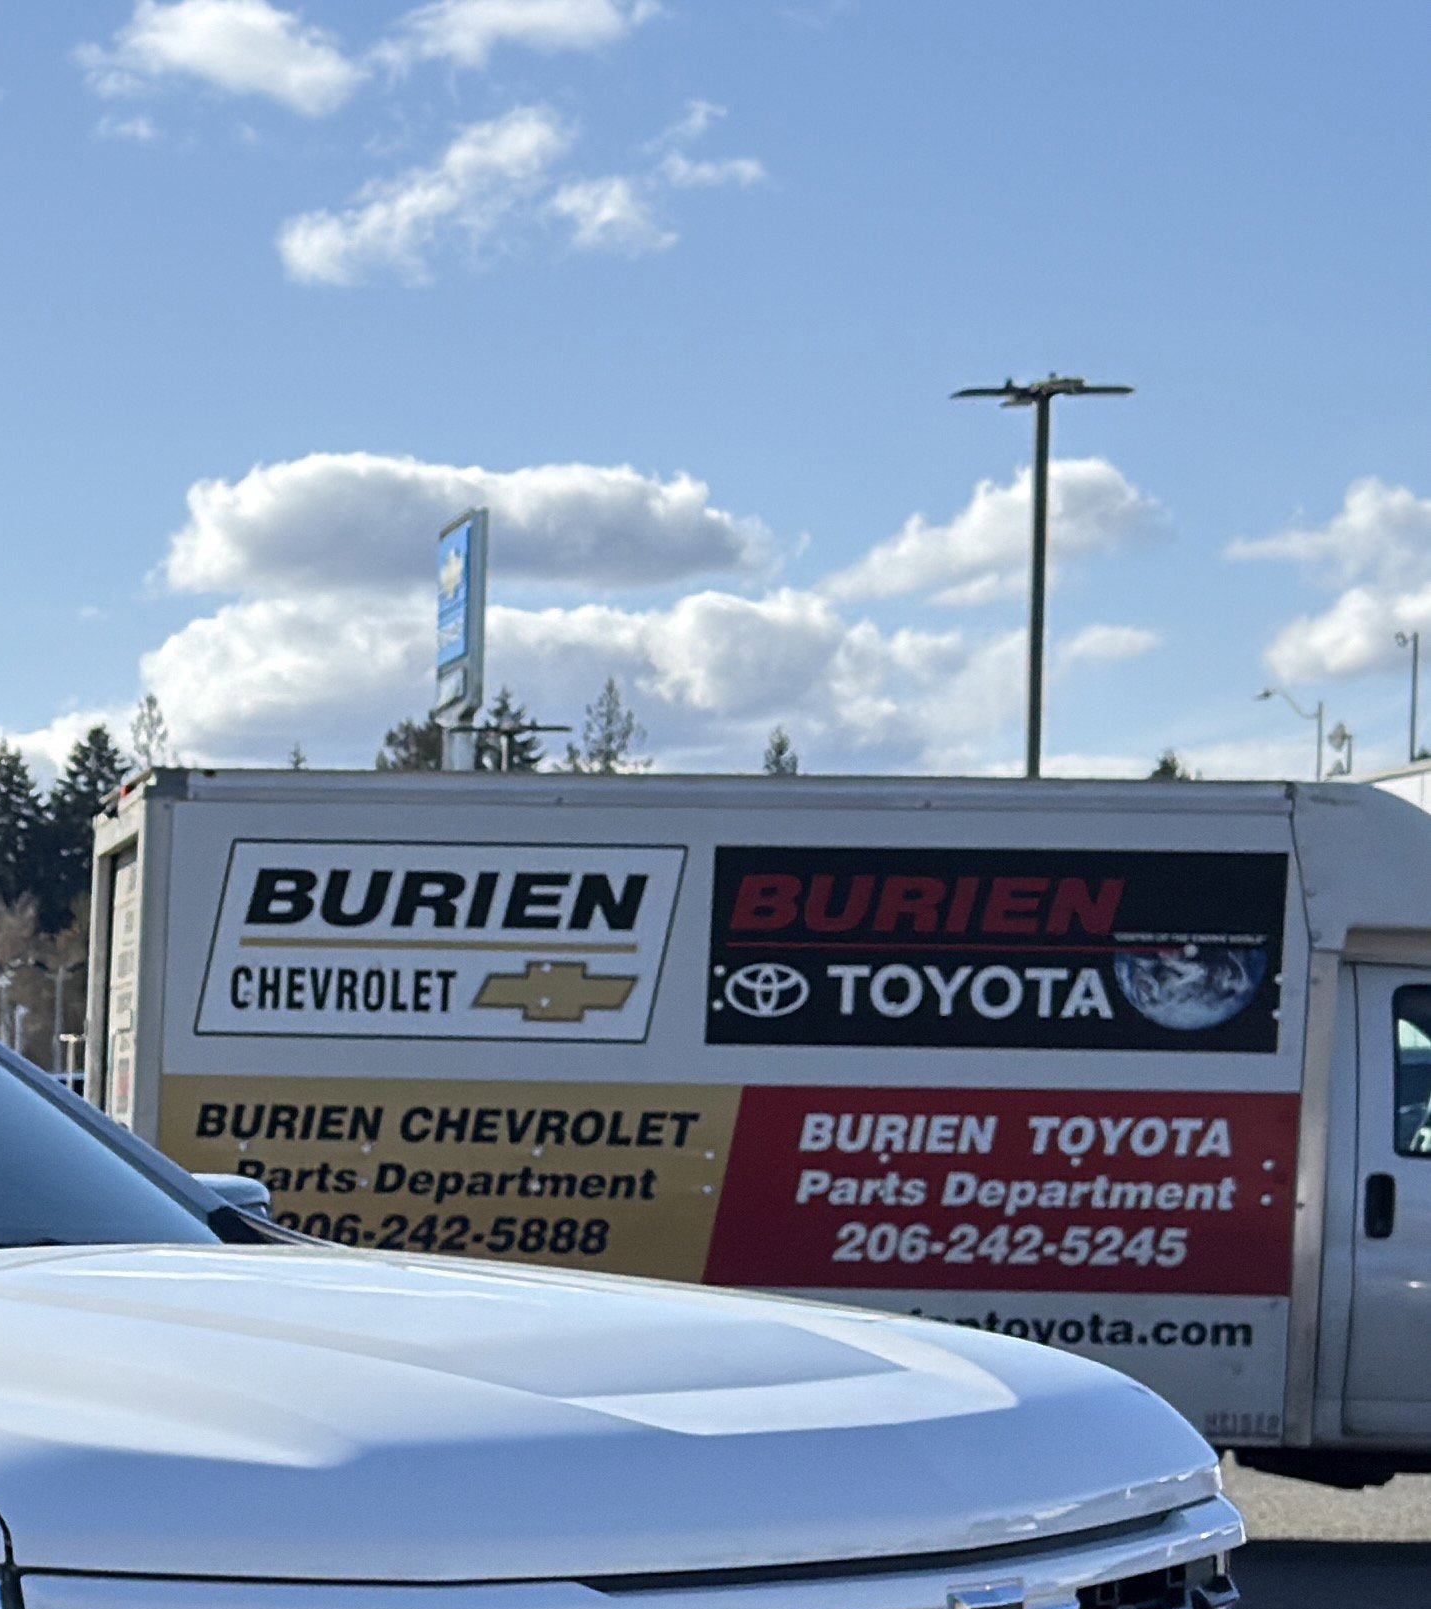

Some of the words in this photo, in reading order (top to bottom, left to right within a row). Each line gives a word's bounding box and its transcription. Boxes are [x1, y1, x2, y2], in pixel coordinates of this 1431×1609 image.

[244, 868, 649, 931] BURIEN
[728, 873, 1125, 935] BURIEN
[230, 964, 458, 1013] CHEVROLET
[827, 963, 1114, 1020] TOYOTA
[195, 1102, 383, 1142] BURIEN
[400, 1105, 701, 1149] CHEVROLET
[798, 1113, 998, 1154] BURIEN
[1028, 1116, 1233, 1159] TOYOTA
[236, 1158, 358, 1193] Parts
[374, 1161, 658, 1204] Department
[795, 1169, 927, 1207] Parts
[941, 1171, 1236, 1217] Department
[831, 1221, 1189, 1268] 206-242-5245
[910, 1307, 1253, 1348] toyota.com
